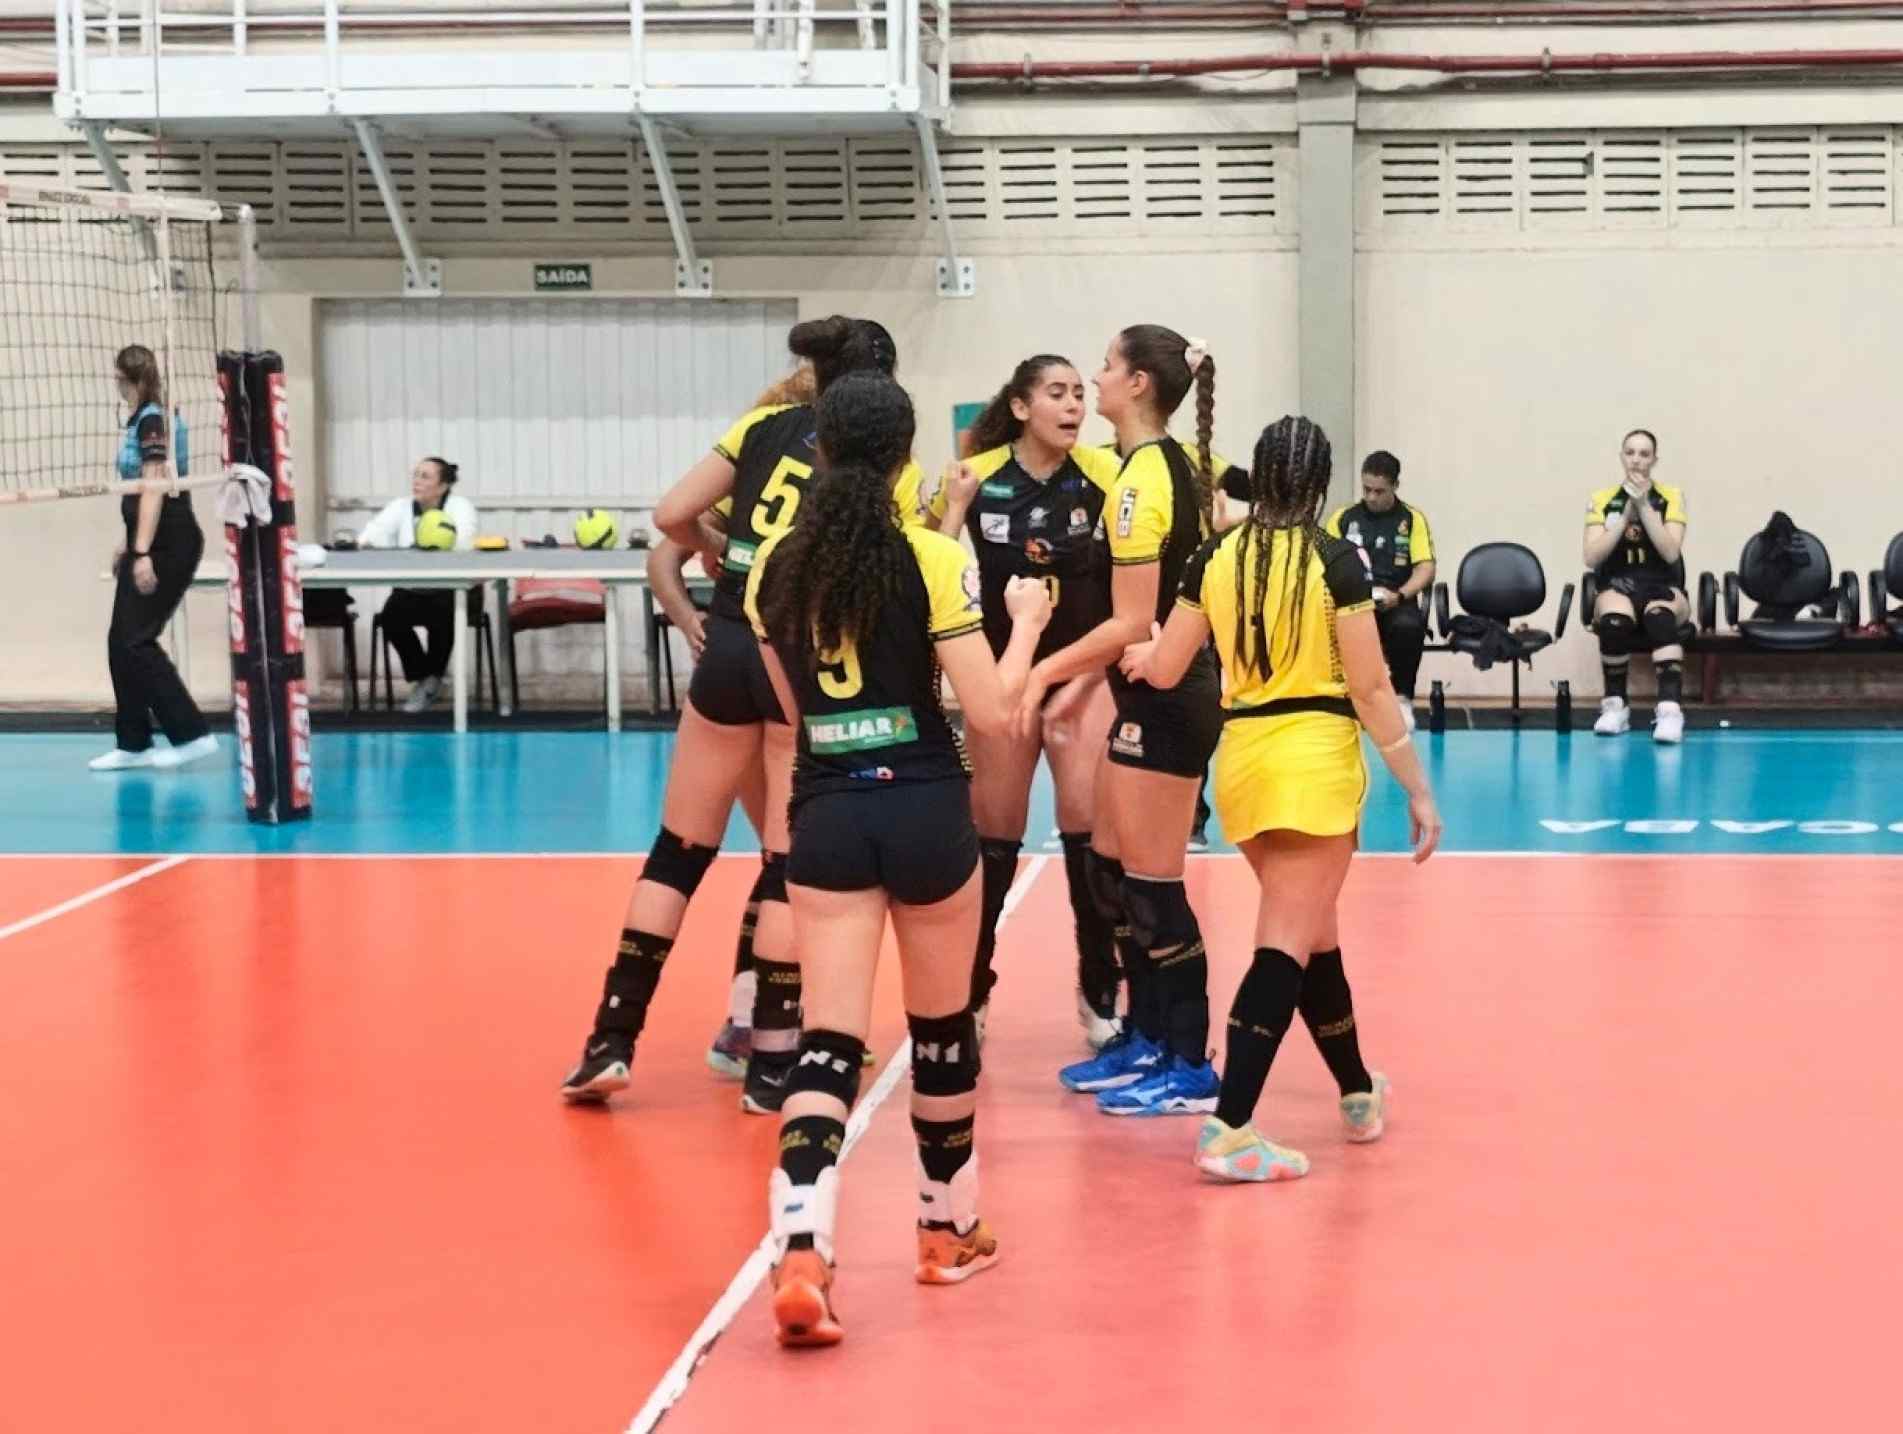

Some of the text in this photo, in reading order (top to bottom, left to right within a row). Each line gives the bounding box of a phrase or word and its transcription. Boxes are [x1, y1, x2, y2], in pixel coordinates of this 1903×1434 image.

[536, 268, 588, 284] SAÍDA
[750, 455, 813, 537] 5
[811, 717, 893, 743] HELIAR
